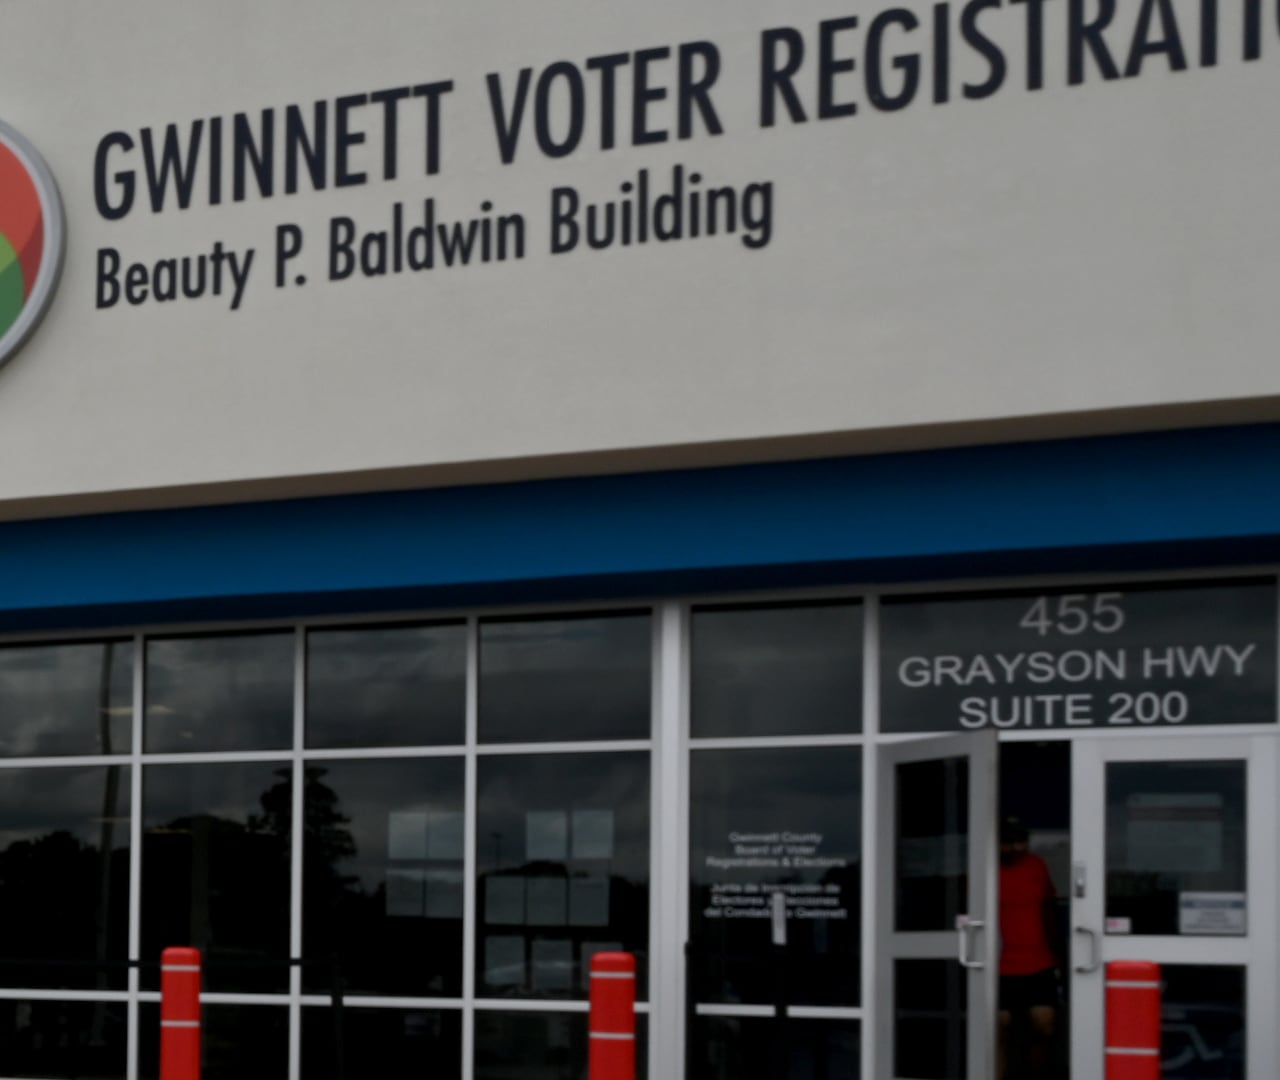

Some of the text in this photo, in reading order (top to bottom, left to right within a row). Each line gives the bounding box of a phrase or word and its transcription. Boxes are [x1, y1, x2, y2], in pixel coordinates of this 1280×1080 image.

[94, 0, 1280, 220] GWINNETT VOTER REGISTRATI
[96, 165, 772, 310] Beauty P. Baldwin Building
[1020, 593, 1125, 636] 455
[898, 643, 1255, 687] GRAYSON HWY
[959, 691, 1188, 728] SUITE 200
